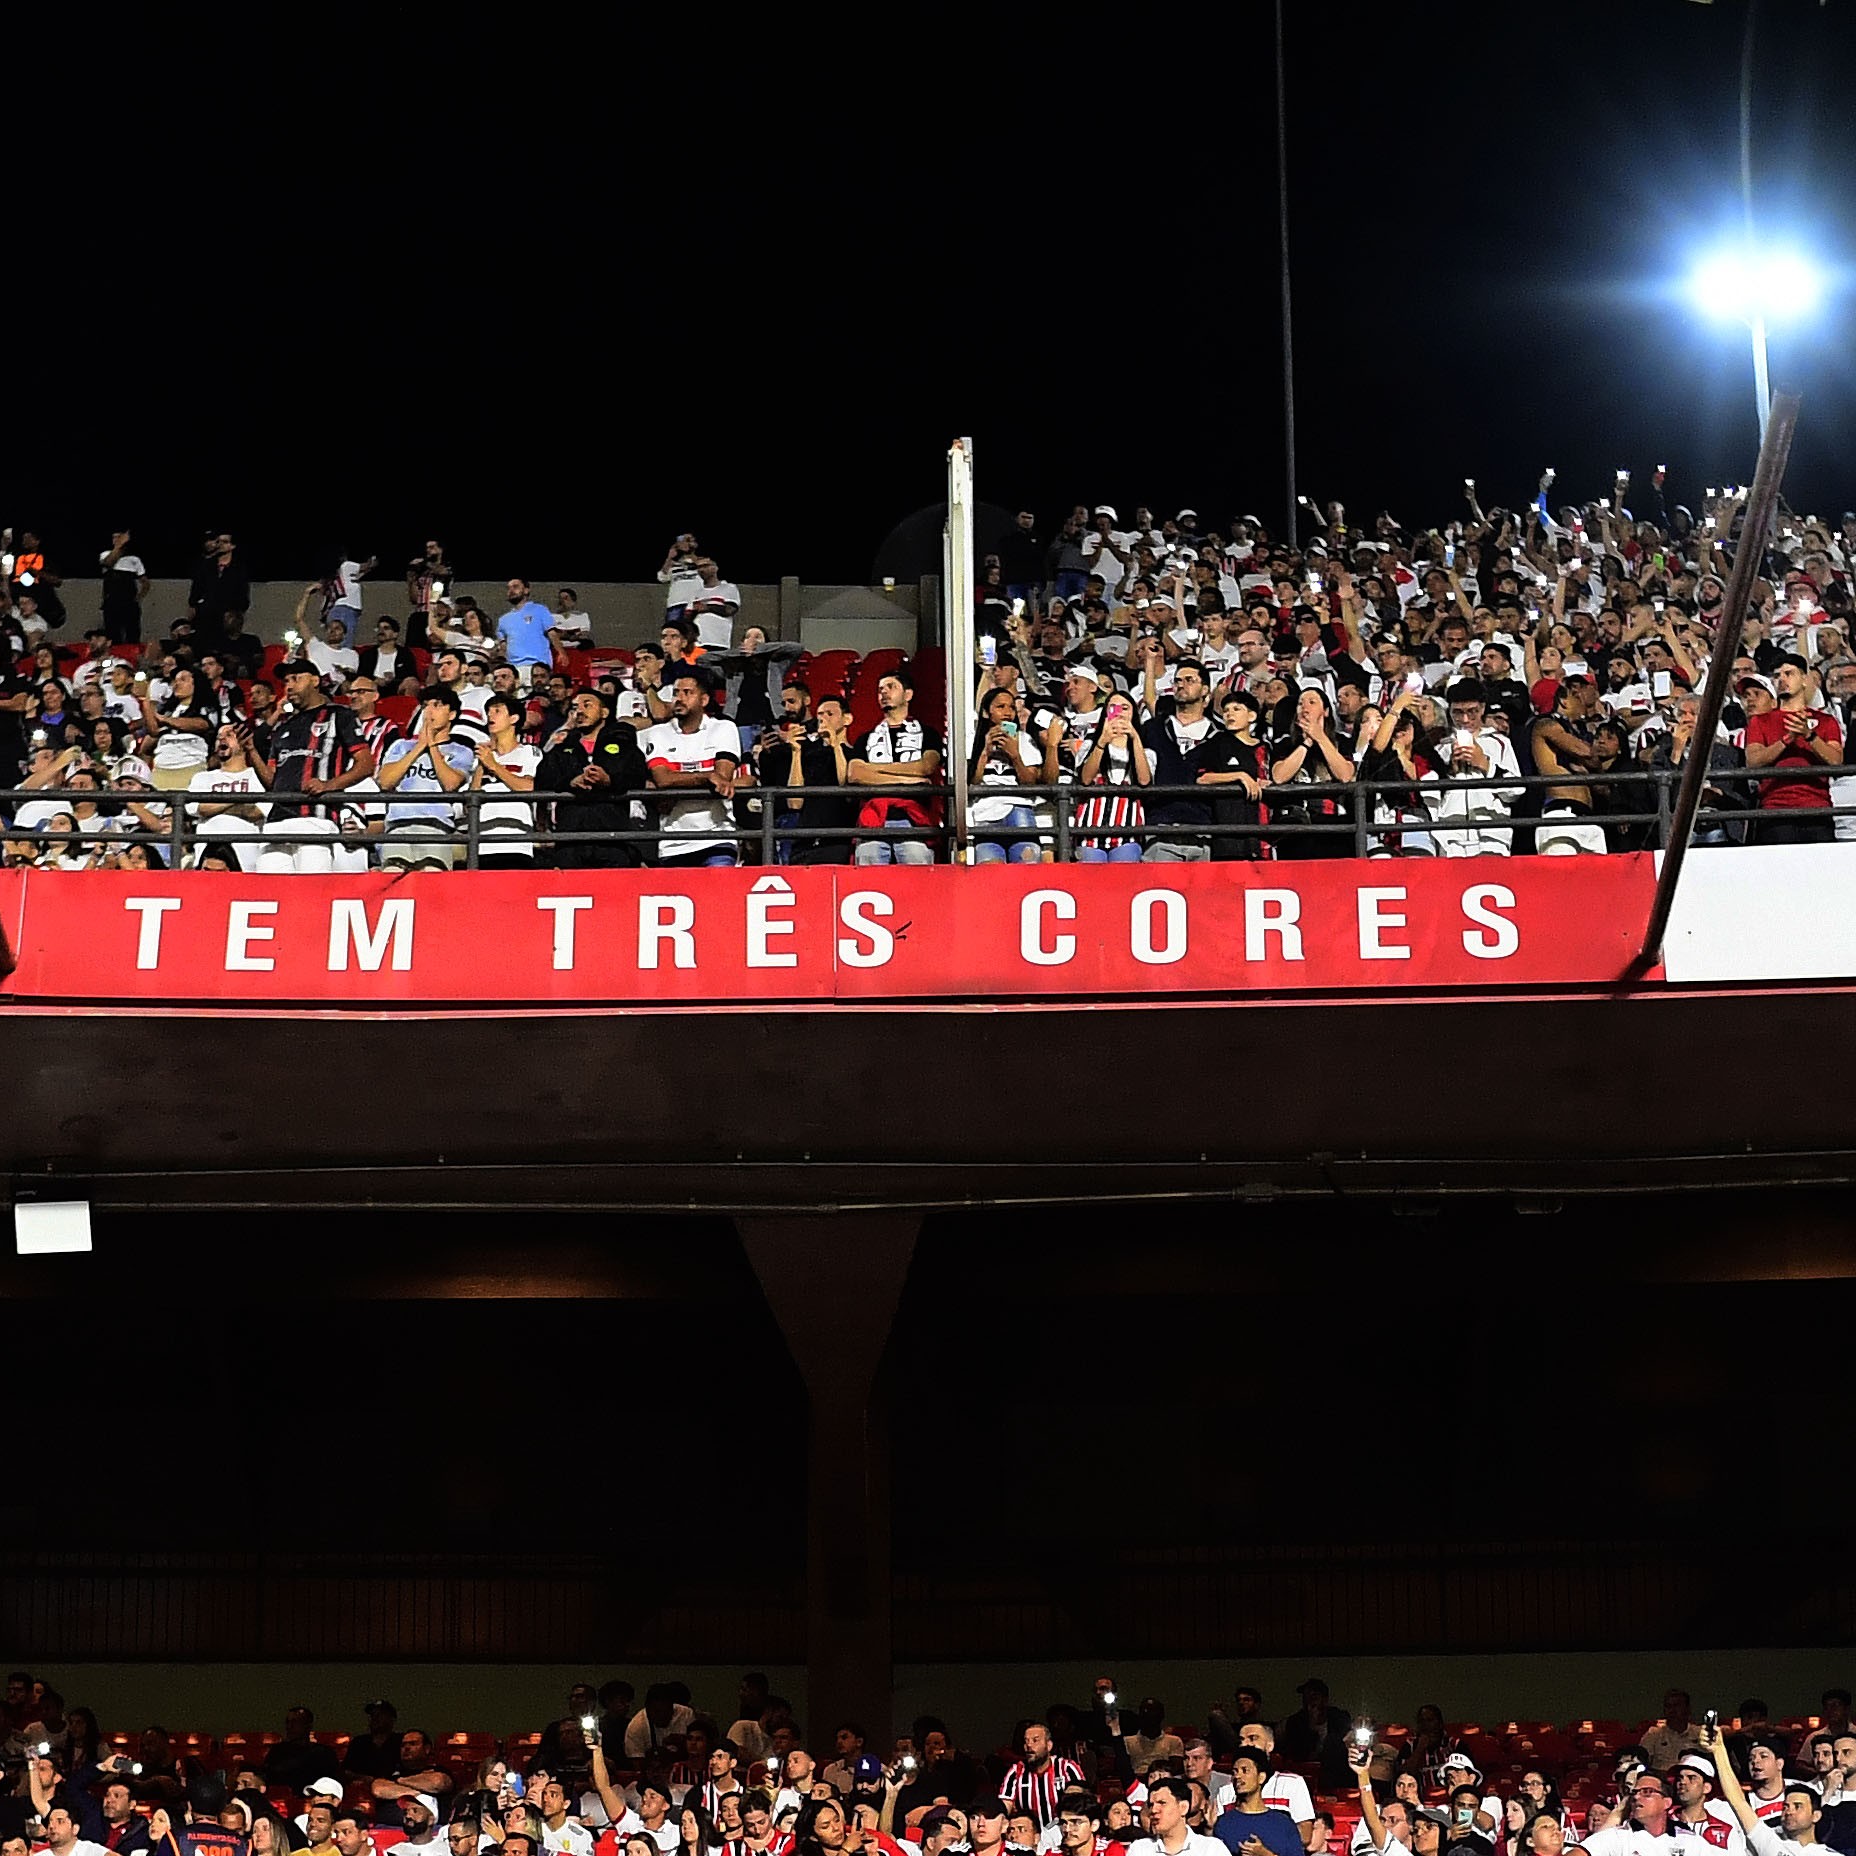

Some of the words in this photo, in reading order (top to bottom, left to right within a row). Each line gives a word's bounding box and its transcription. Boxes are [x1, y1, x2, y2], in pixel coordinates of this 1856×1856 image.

[407, 763, 436, 780] nte
[124, 896, 416, 972] TEM
[536, 874, 896, 970] TRÊS
[1019, 882, 1520, 967] CORES
